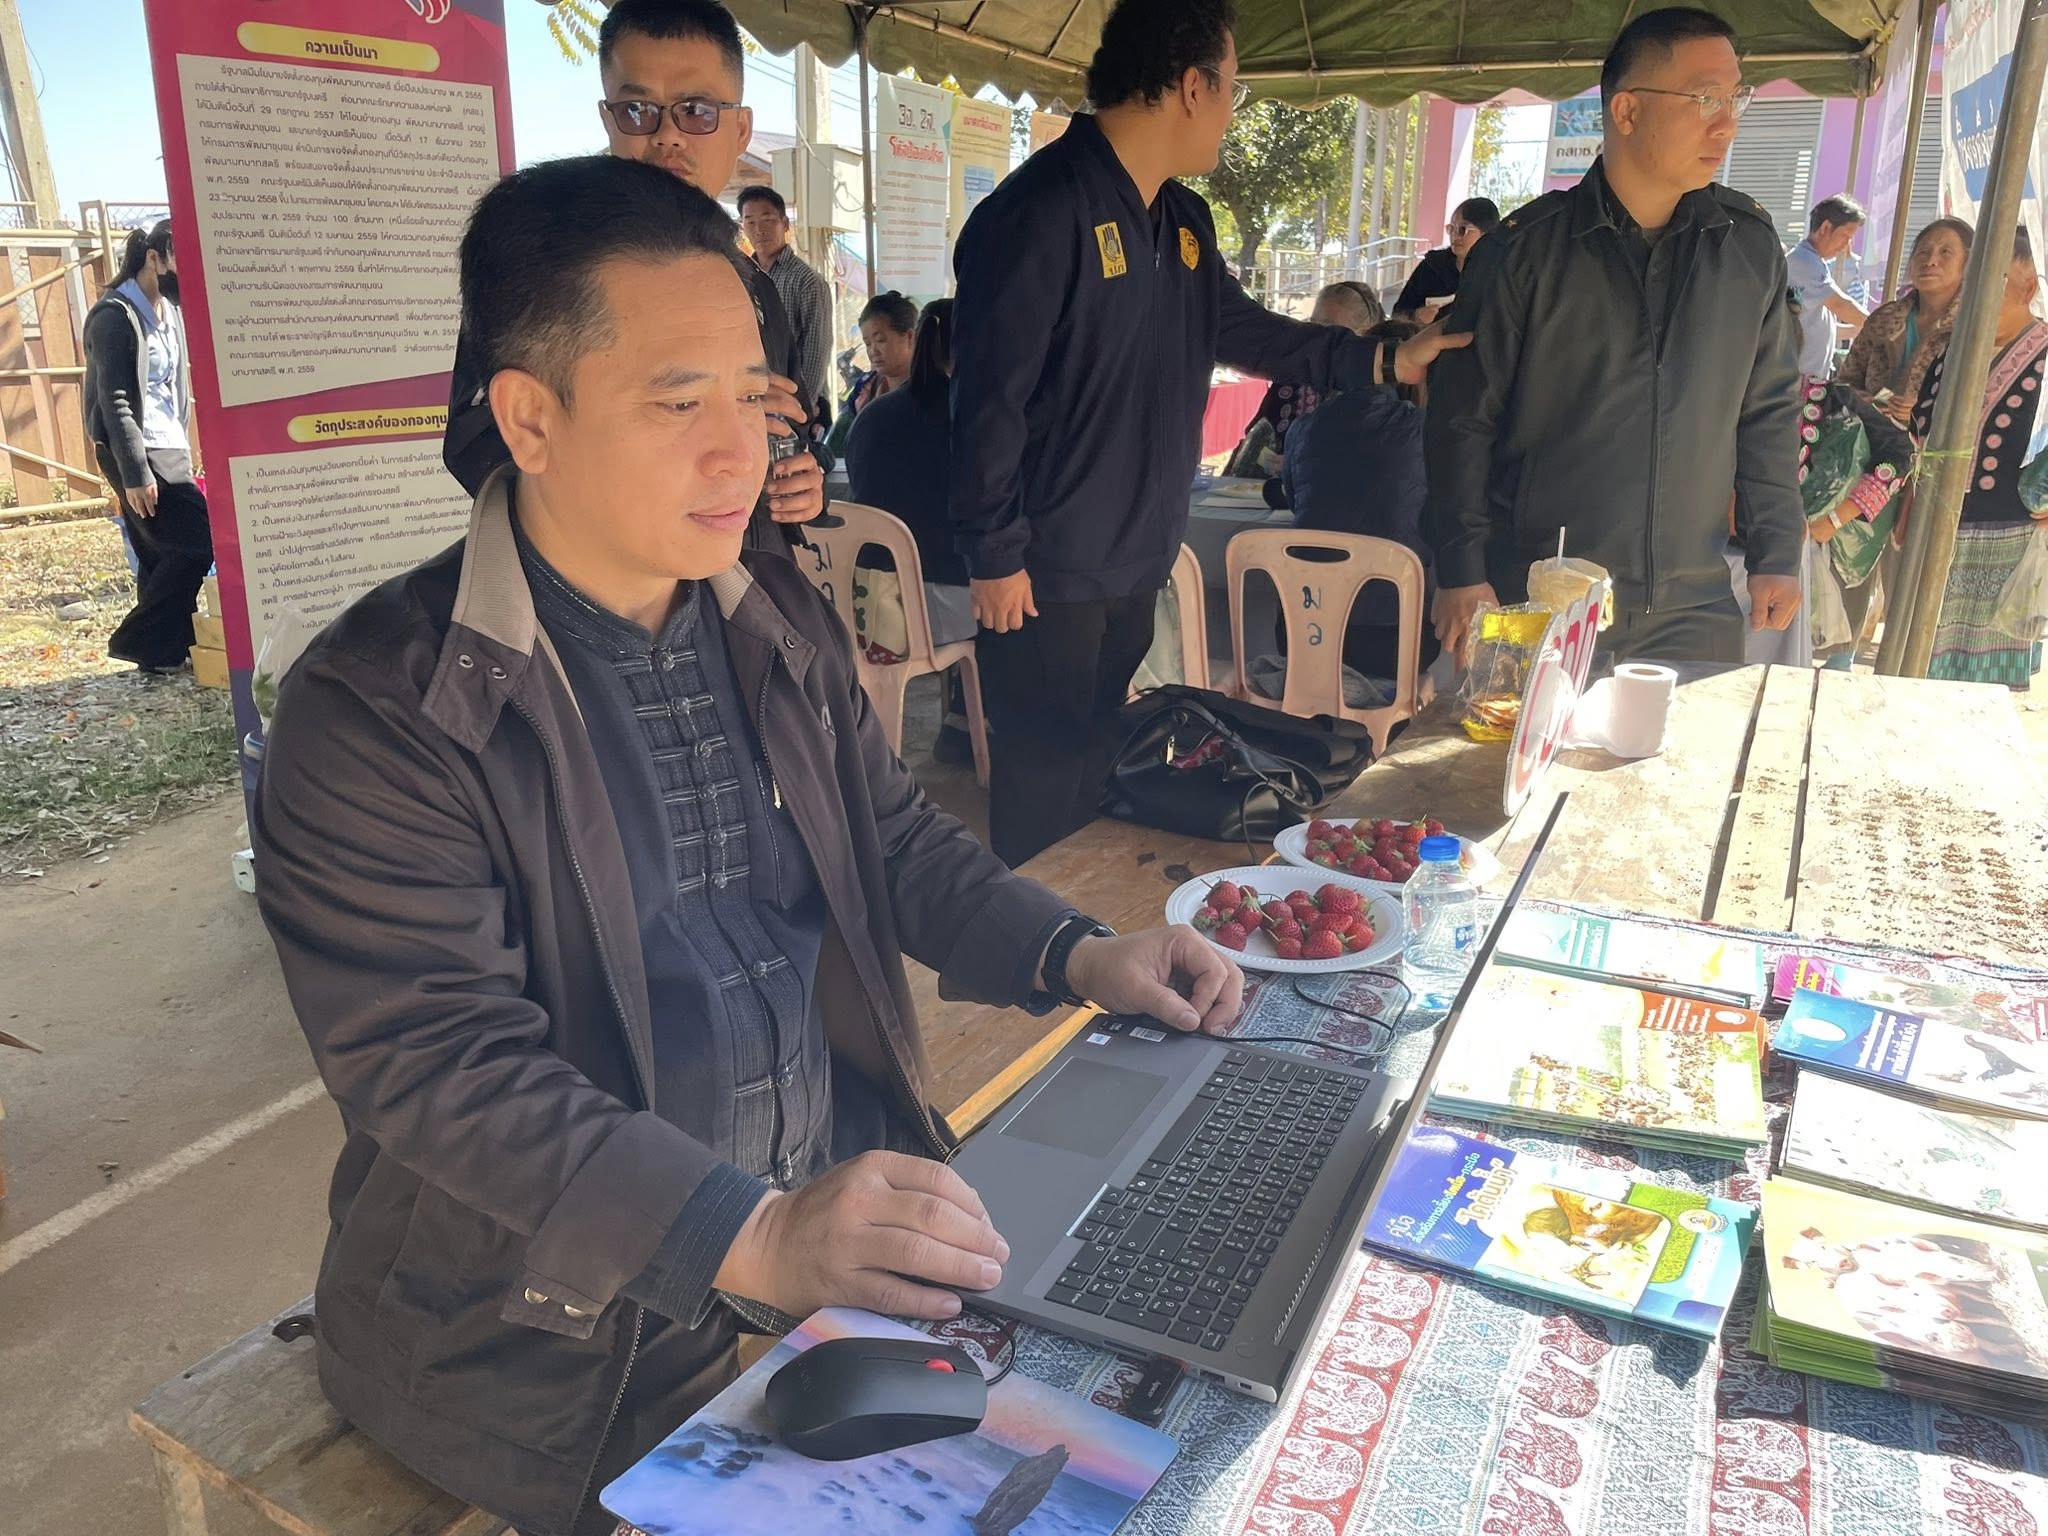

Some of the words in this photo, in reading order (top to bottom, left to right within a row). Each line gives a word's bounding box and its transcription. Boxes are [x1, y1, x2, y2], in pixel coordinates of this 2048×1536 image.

[305, 39, 378, 60] ความเป็นมา
[260, 106, 272, 114] 29
[314, 110, 334, 120] 2557
[199, 119, 281, 135] กรมการพัฒนาชุมชน
[419, 136, 429, 144] 17
[201, 136, 294, 154] ให้กรมการพัฒนาชุมชน
[204, 157, 280, 169] พัฒนาบทบาทสตรี
[206, 175, 224, 184] พ.ศ.
[227, 175, 250, 185] 2559
[208, 193, 220, 202] 23
[257, 195, 278, 204] 2558
[211, 211, 255, 222] งบประมาณ
[333, 214, 348, 223] 100
[354, 213, 384, 225] ล้านบาท
[213, 227, 265, 239] คณะรัฐมนตรี
[314, 231, 323, 240] 12
[357, 232, 378, 241] 2559
[334, 265, 355, 274] 2559
[227, 334, 246, 343] สตรี
[231, 366, 277, 377] บทบาทสตรี
[297, 365, 315, 374] 2559
[314, 413, 447, 436] วัตถุประสงค์ของกองทุน
